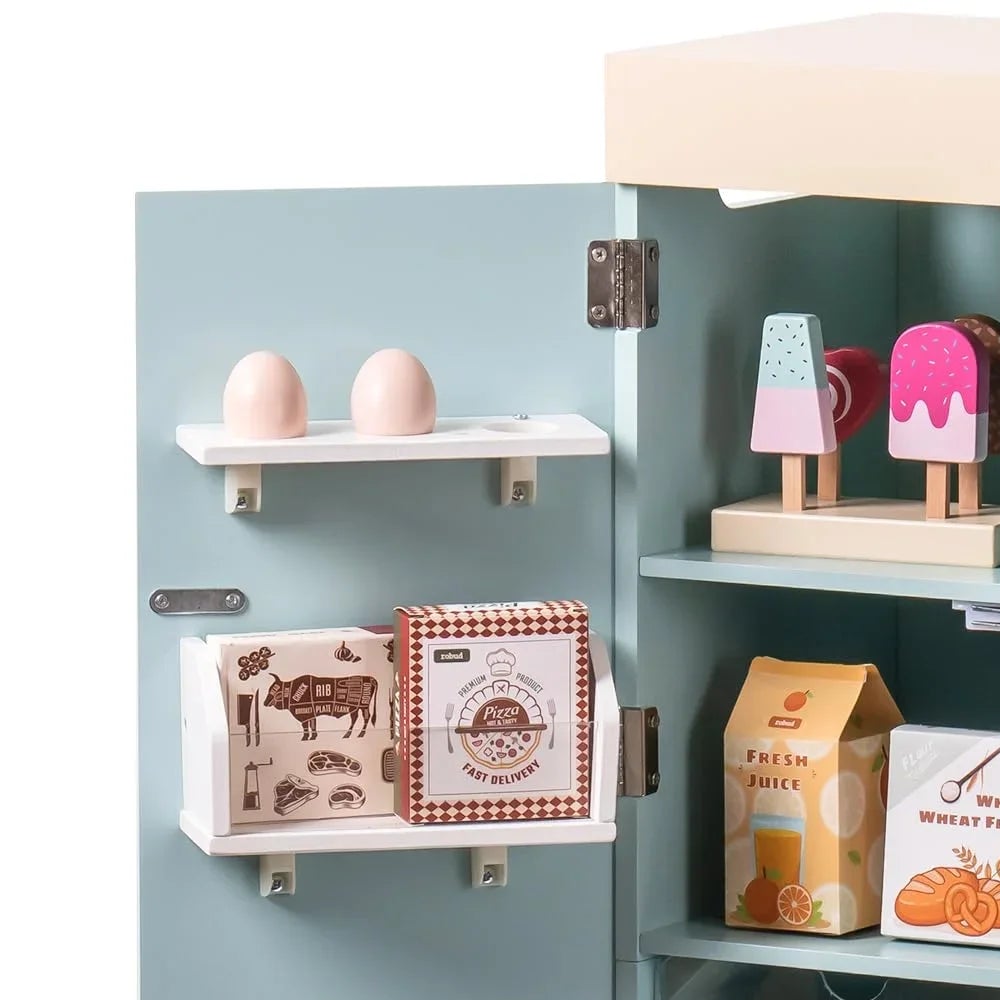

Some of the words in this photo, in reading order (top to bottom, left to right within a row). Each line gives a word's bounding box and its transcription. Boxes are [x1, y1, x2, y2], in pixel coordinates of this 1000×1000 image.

[440, 650, 464, 660] robud
[292, 682, 309, 702] CHUCK
[316, 684, 331, 697] RIB
[458, 674, 487, 698] PREMIUM
[515, 672, 544, 694] PRODUCT
[316, 704, 331, 713] PLATE
[483, 705, 520, 720] Pizza
[746, 749, 808, 767] FRESH
[462, 762, 488, 783] FAST
[491, 759, 540, 785] DELIVERY
[746, 774, 801, 791] JUICE
[919, 810, 981, 828] WHEAT
